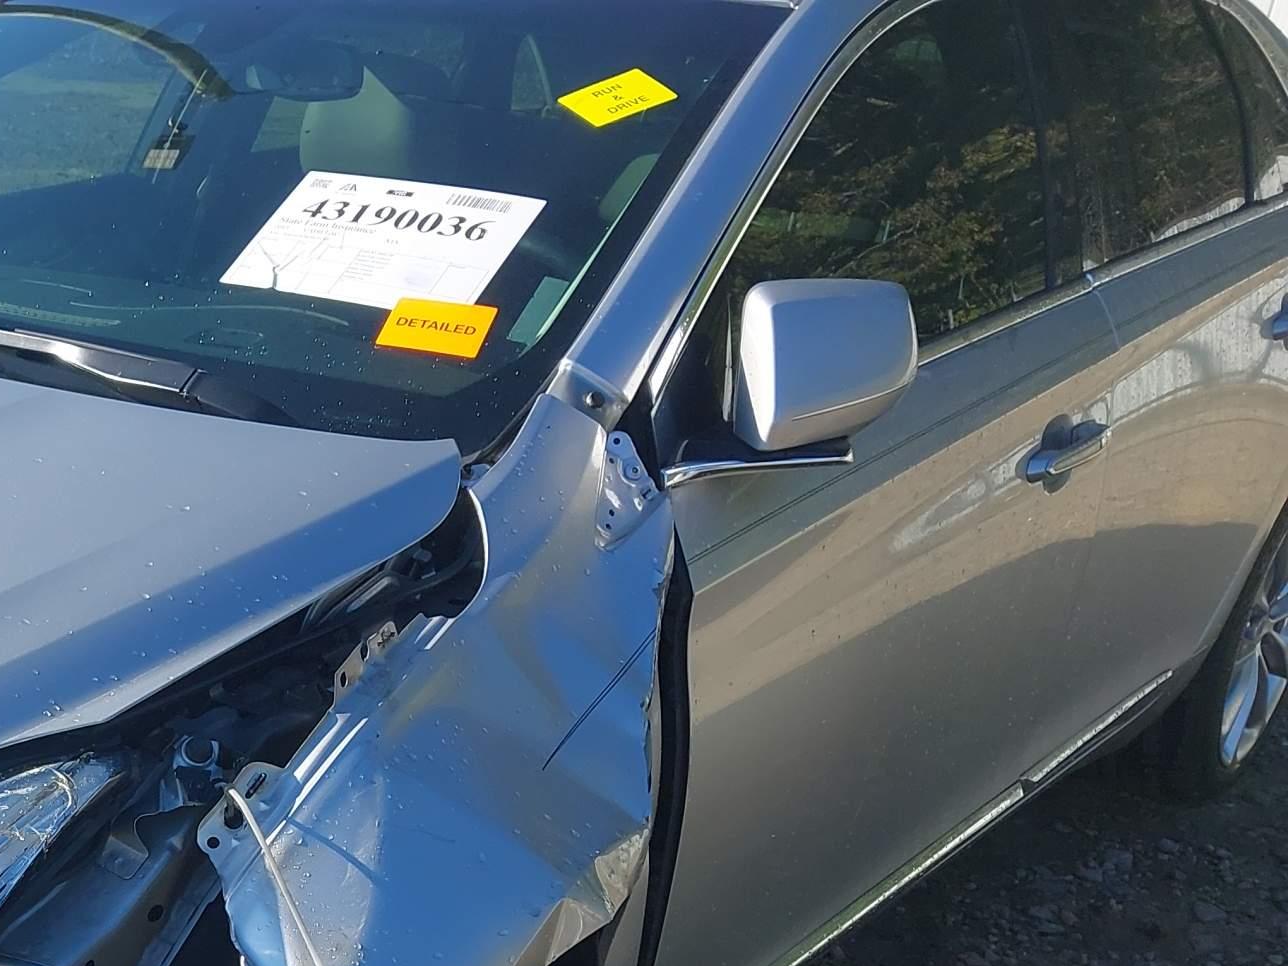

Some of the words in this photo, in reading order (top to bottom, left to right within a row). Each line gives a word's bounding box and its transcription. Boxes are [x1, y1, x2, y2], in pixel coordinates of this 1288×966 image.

[591, 83, 623, 98] RUN
[607, 95, 650, 114] DRIVE
[302, 198, 497, 242] 43190036
[395, 316, 477, 336] DETAILED
